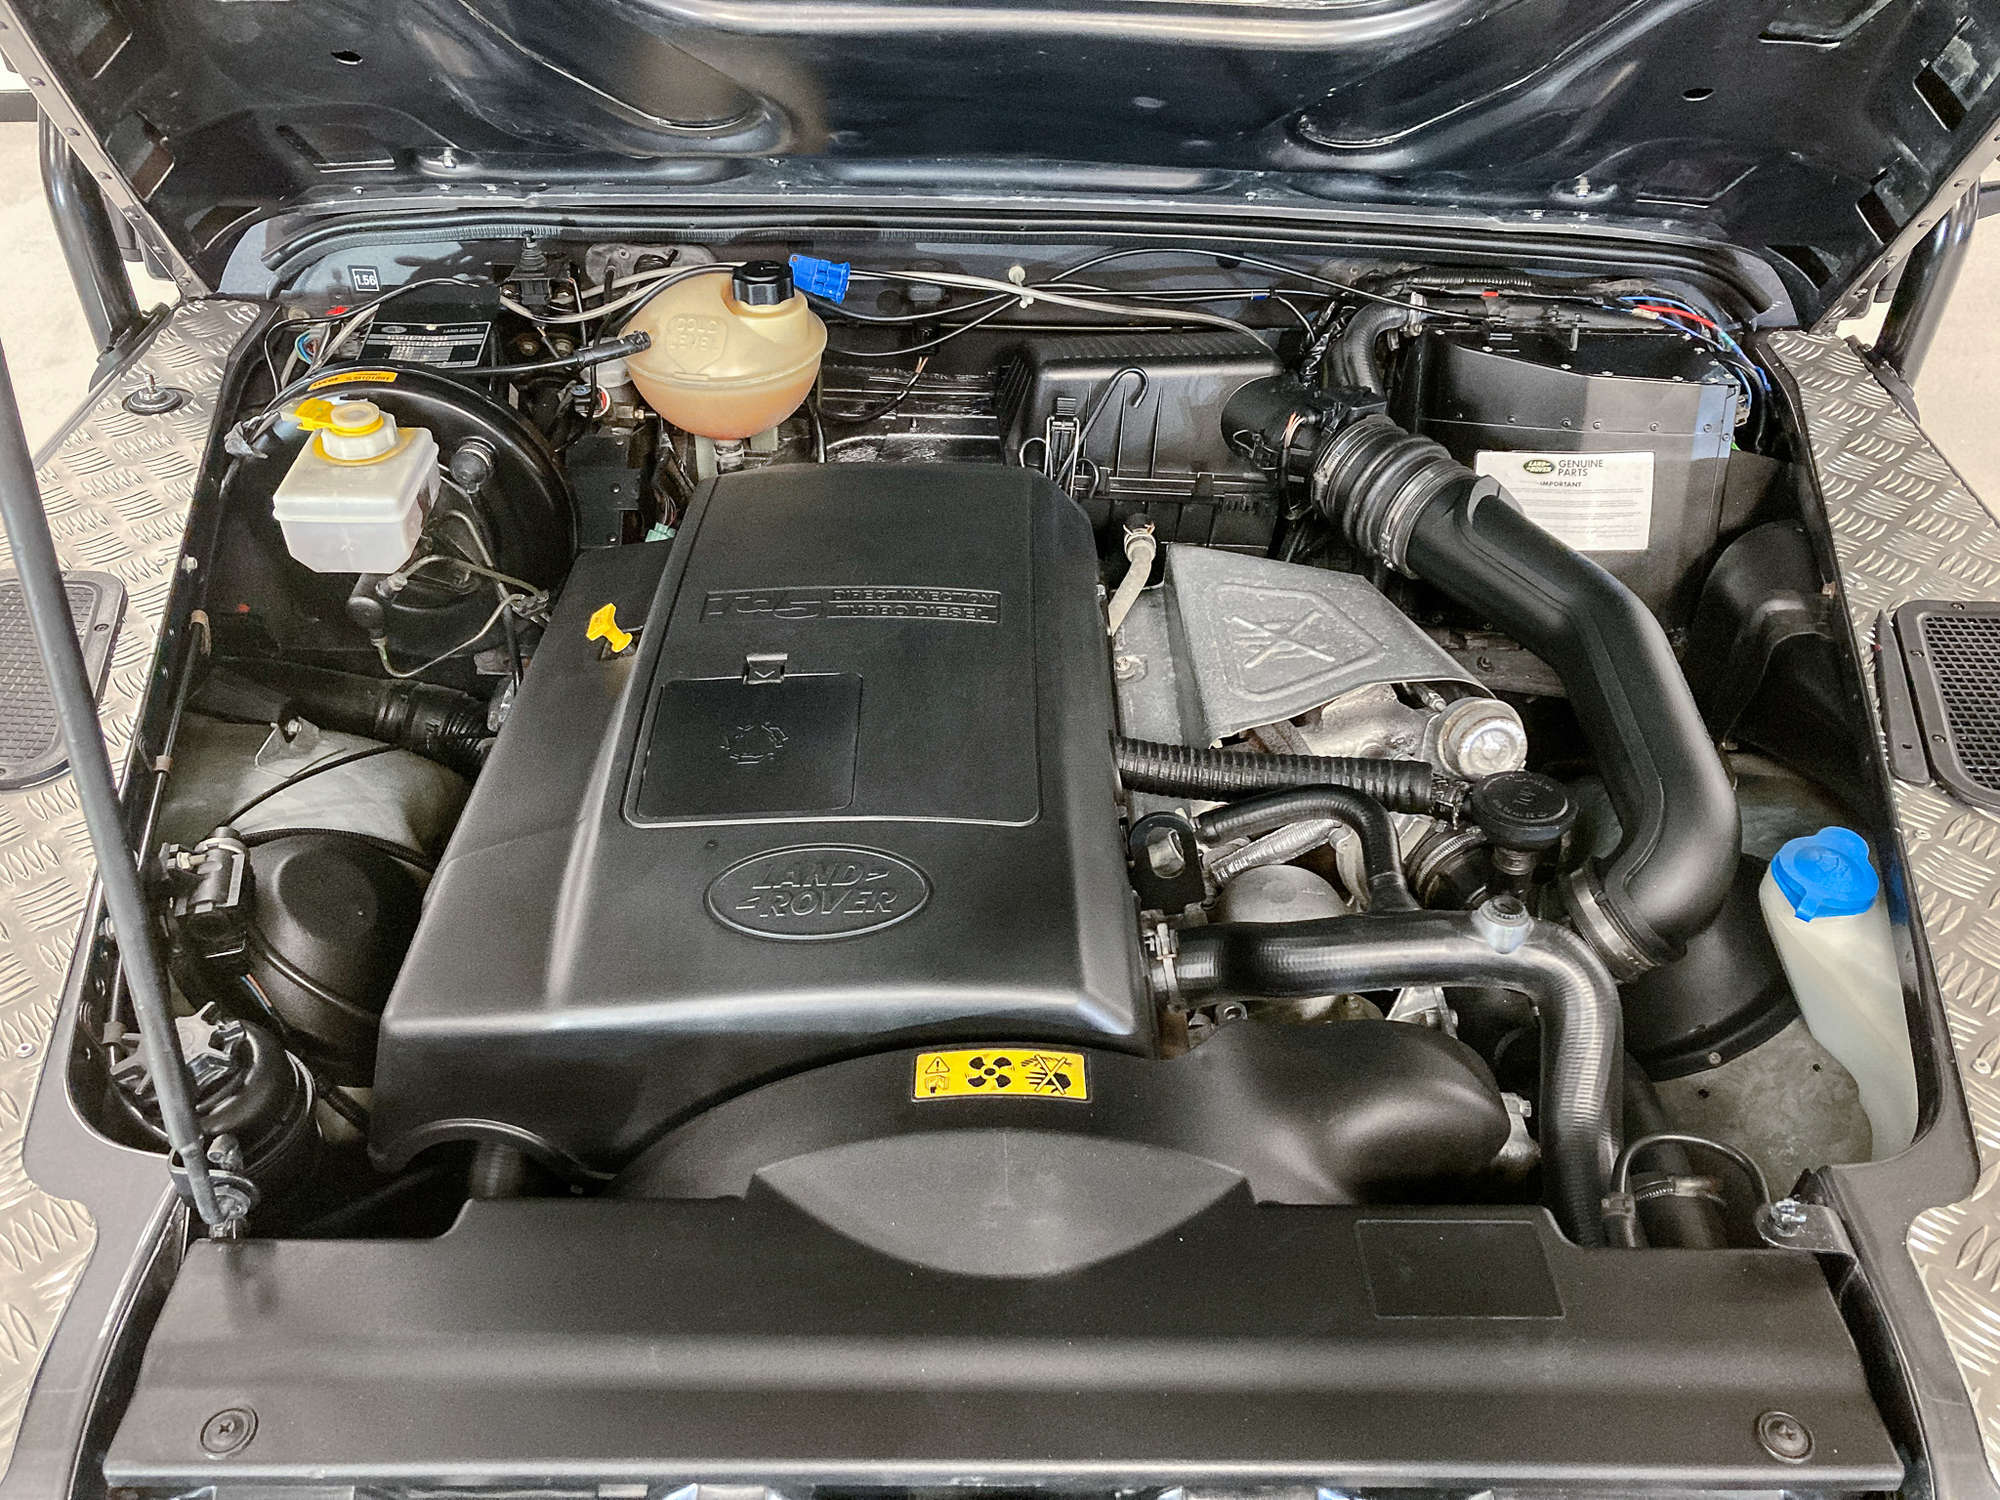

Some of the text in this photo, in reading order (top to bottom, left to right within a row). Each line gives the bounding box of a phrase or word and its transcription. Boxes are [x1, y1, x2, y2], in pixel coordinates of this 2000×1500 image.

[1558, 459, 1604, 468] GENUINE
[1558, 468, 1588, 477] PARTS
[833, 589, 993, 603] DIRECT INJECTION
[834, 604, 990, 619] TURBO DIESEL
[752, 862, 864, 889] LAND
[759, 890, 898, 918] ROVER
